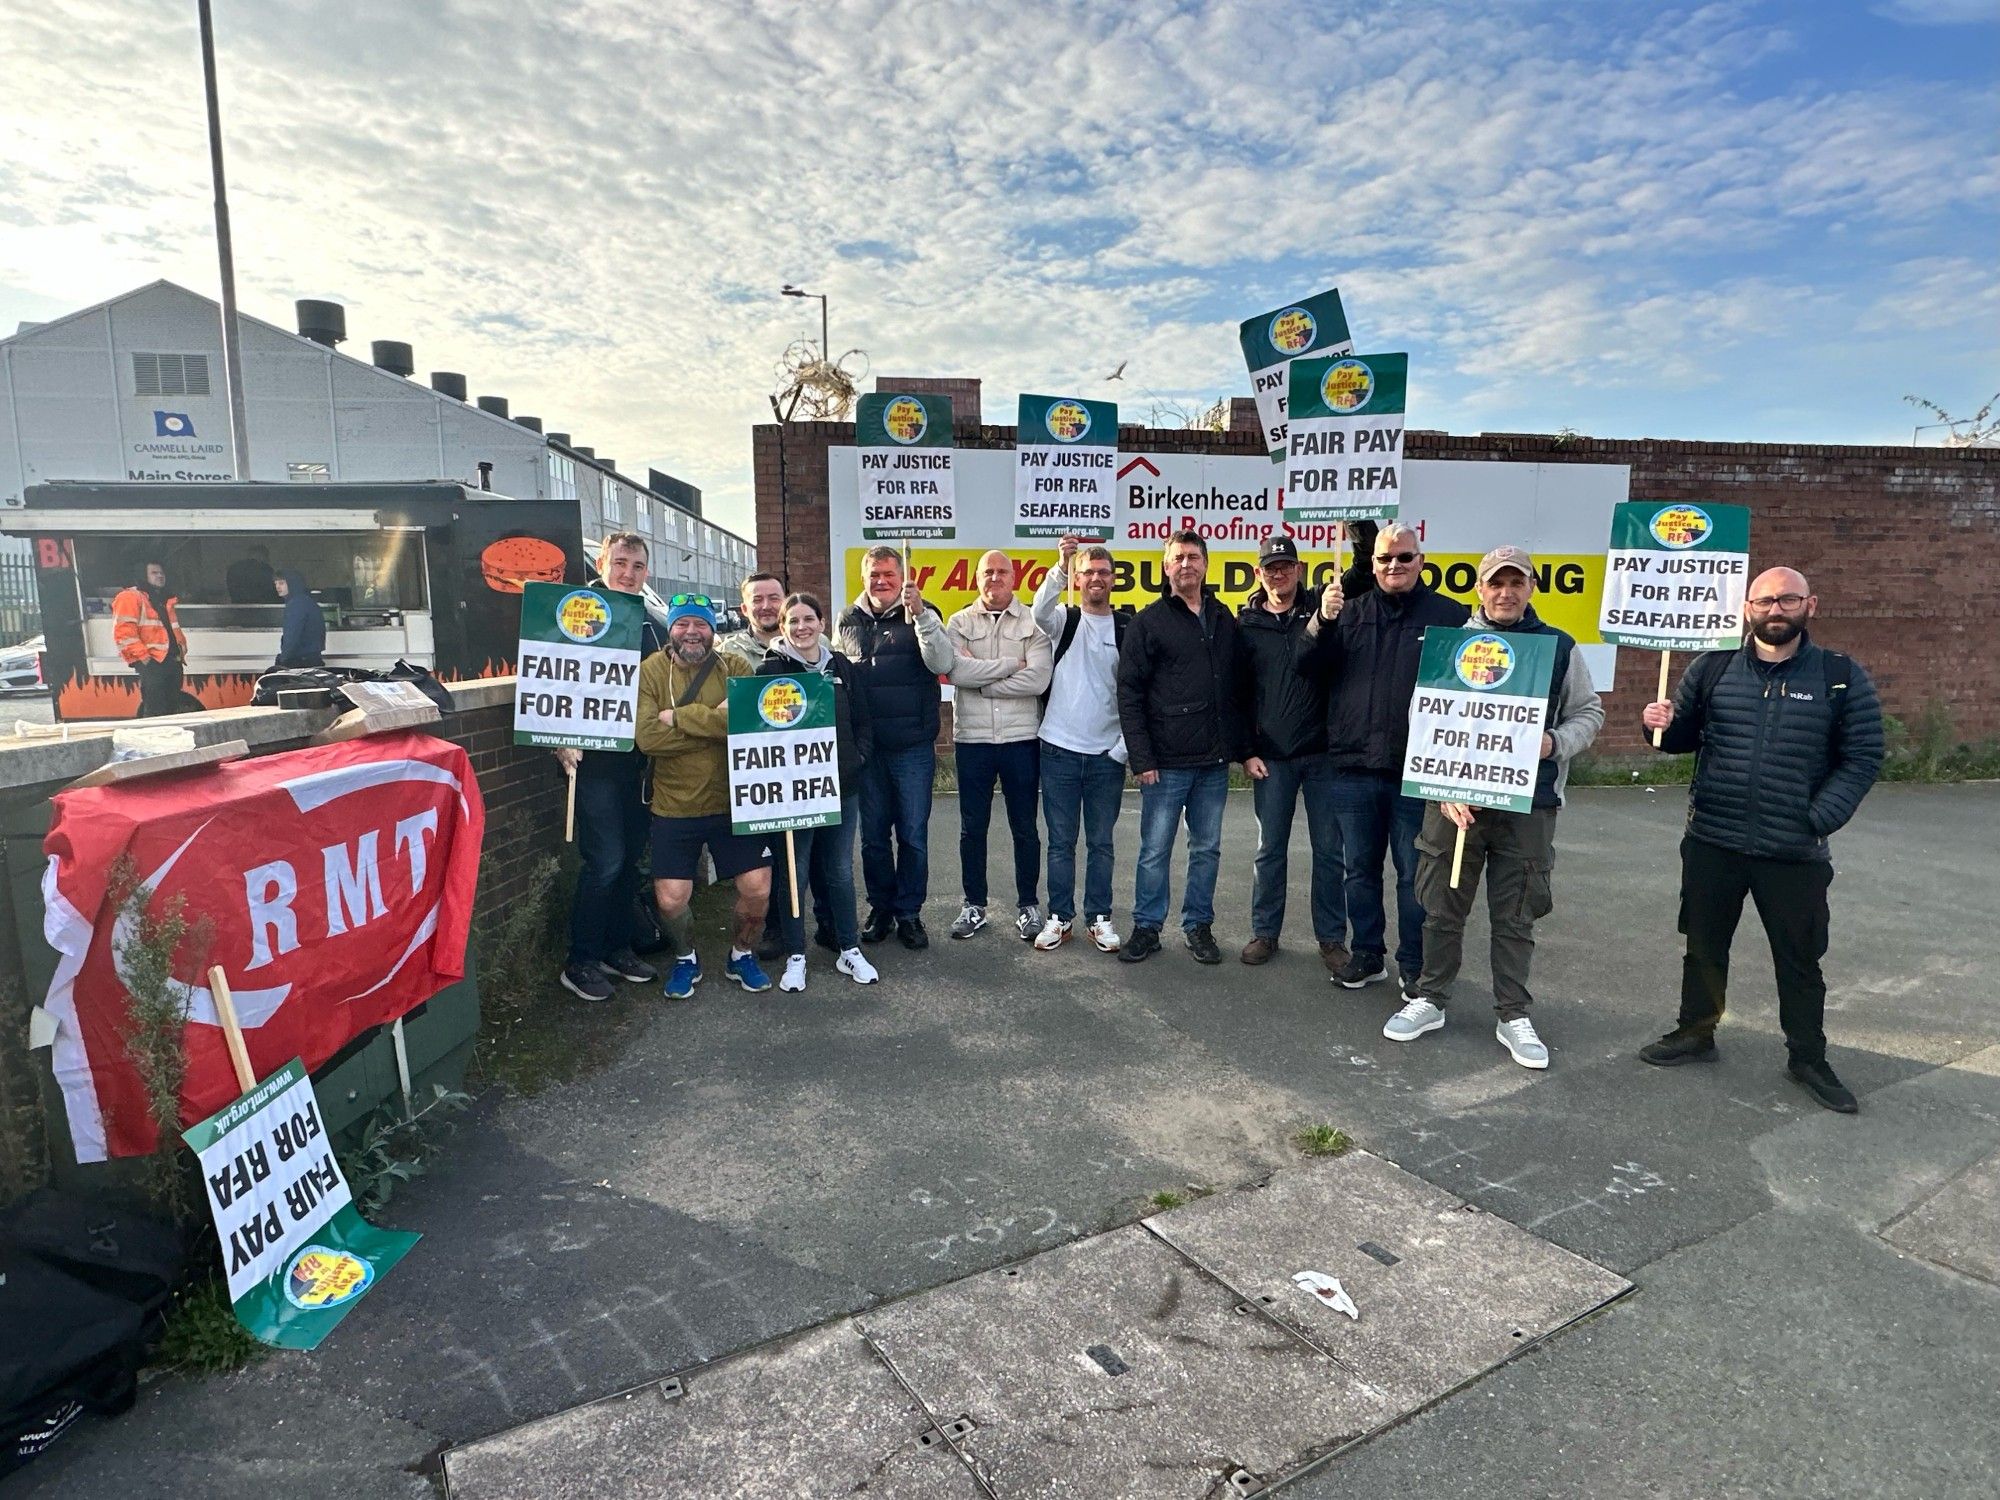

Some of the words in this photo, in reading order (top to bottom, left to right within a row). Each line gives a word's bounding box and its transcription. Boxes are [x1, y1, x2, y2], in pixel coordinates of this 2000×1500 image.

[1256, 370, 1283, 393] PAY
[134, 444, 188, 453] CAMMELL
[191, 444, 223, 453] LAIRD
[1291, 432, 1345, 457] FAIR
[1354, 429, 1402, 453] PAY
[862, 455, 889, 469] PAY
[893, 455, 951, 469] JUSTICE
[1021, 452, 1049, 467] PAY
[1052, 453, 1114, 468] JUSTICE
[877, 480, 905, 494] FOR
[910, 480, 938, 494] RFA
[1034, 478, 1063, 492] FOR
[1069, 478, 1098, 493] RFA
[1289, 469, 1338, 493] FOR
[1347, 467, 1398, 491] RFA
[1129, 485, 1268, 511] Birkenhead
[865, 505, 953, 520] SEAFARERS
[1020, 503, 1111, 519] SEAFARERS
[1300, 507, 1382, 519] www.rmt.org.uk
[1670, 513, 1687, 521] Pay
[875, 527, 944, 538] www.rmt.org.uk
[1128, 516, 1172, 539] and
[1667, 532, 1692, 542] RFA
[1613, 557, 1651, 572] PAY
[1656, 559, 1743, 575] JUSTICE
[1630, 584, 1670, 601] FOR
[1678, 586, 1719, 602] RFA
[574, 599, 591, 611] Pay
[1606, 609, 1737, 629] SEAFARERS
[1475, 644, 1493, 656] Pay
[1618, 635, 1720, 650] www.rmt.org.uk
[522, 655, 581, 682] FAIR
[590, 661, 637, 687] PAY
[520, 692, 572, 719] FOR
[583, 697, 633, 722] RFA
[1418, 696, 1454, 715] PAY
[1458, 701, 1540, 724] JUSTICE
[531, 734, 617, 749] www.rmt.org.uk
[1433, 728, 1469, 748] FOR
[1476, 733, 1513, 753] RFA
[733, 745, 786, 771] FAIR
[794, 741, 834, 766] PAY
[1409, 756, 1530, 787] SEAFARERS
[735, 781, 784, 807] FOR
[792, 776, 837, 801] RFA
[1419, 784, 1512, 806] www.rmt.org.uk
[749, 813, 826, 832] www.rmt.org.uk
[243, 806, 438, 972] RMT
[213, 1069, 294, 1135] www.rmt.org.uk
[271, 1100, 321, 1163] FOR
[208, 1140, 272, 1211] RFA
[283, 1153, 341, 1221] FAIR
[230, 1200, 285, 1276] PAY
